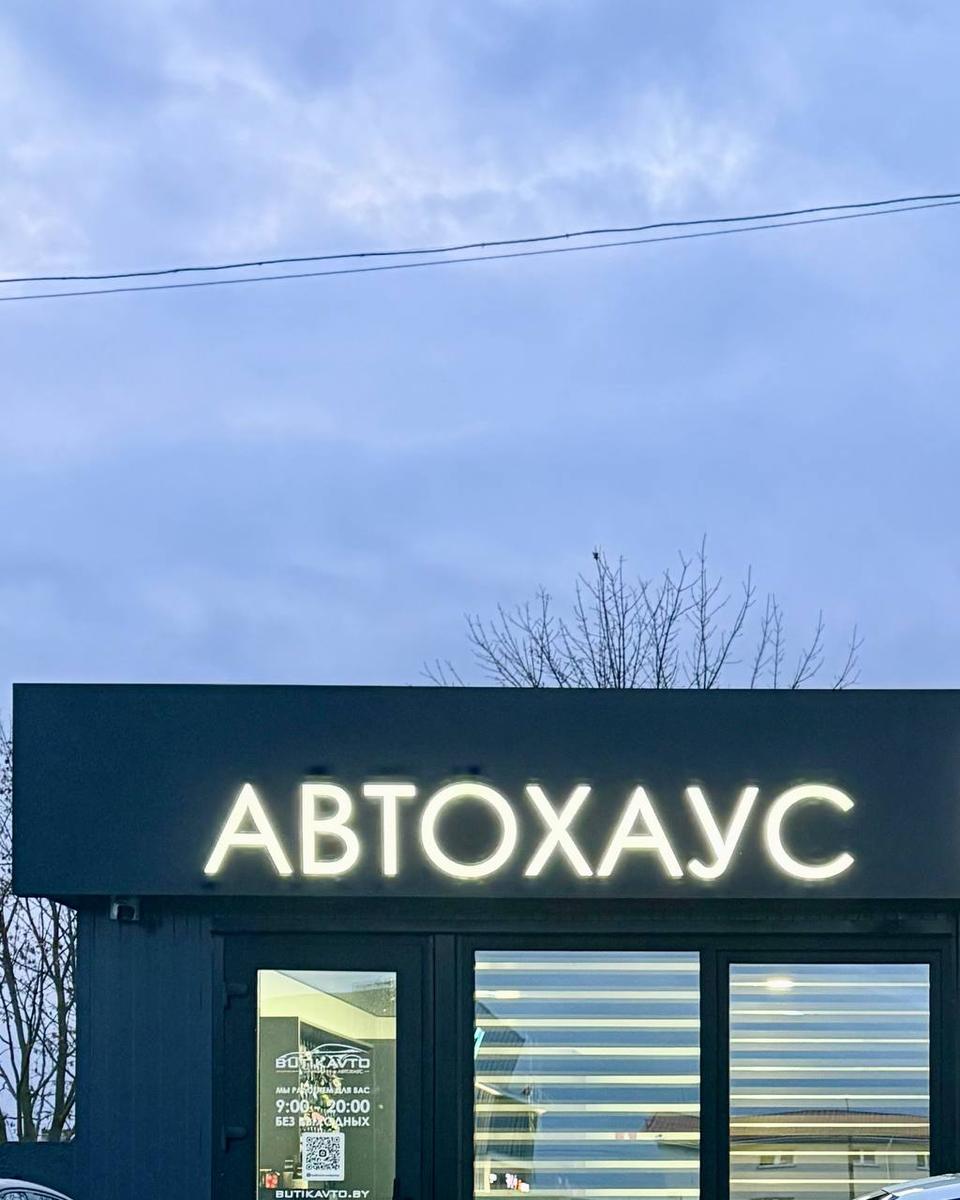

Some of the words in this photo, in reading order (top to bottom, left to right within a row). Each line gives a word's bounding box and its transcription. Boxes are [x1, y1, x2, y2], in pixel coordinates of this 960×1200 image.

[203, 781, 856, 881] АВТОХАУС
[275, 1086, 290, 1094] МЫ
[353, 1086, 371, 1094] ВАС
[275, 1099, 310, 1114] 9:00
[326, 1099, 371, 1114] 20:00
[275, 1116, 295, 1127] БЕЗ
[275, 1189, 370, 1199] BUTIKAVTO.BY
